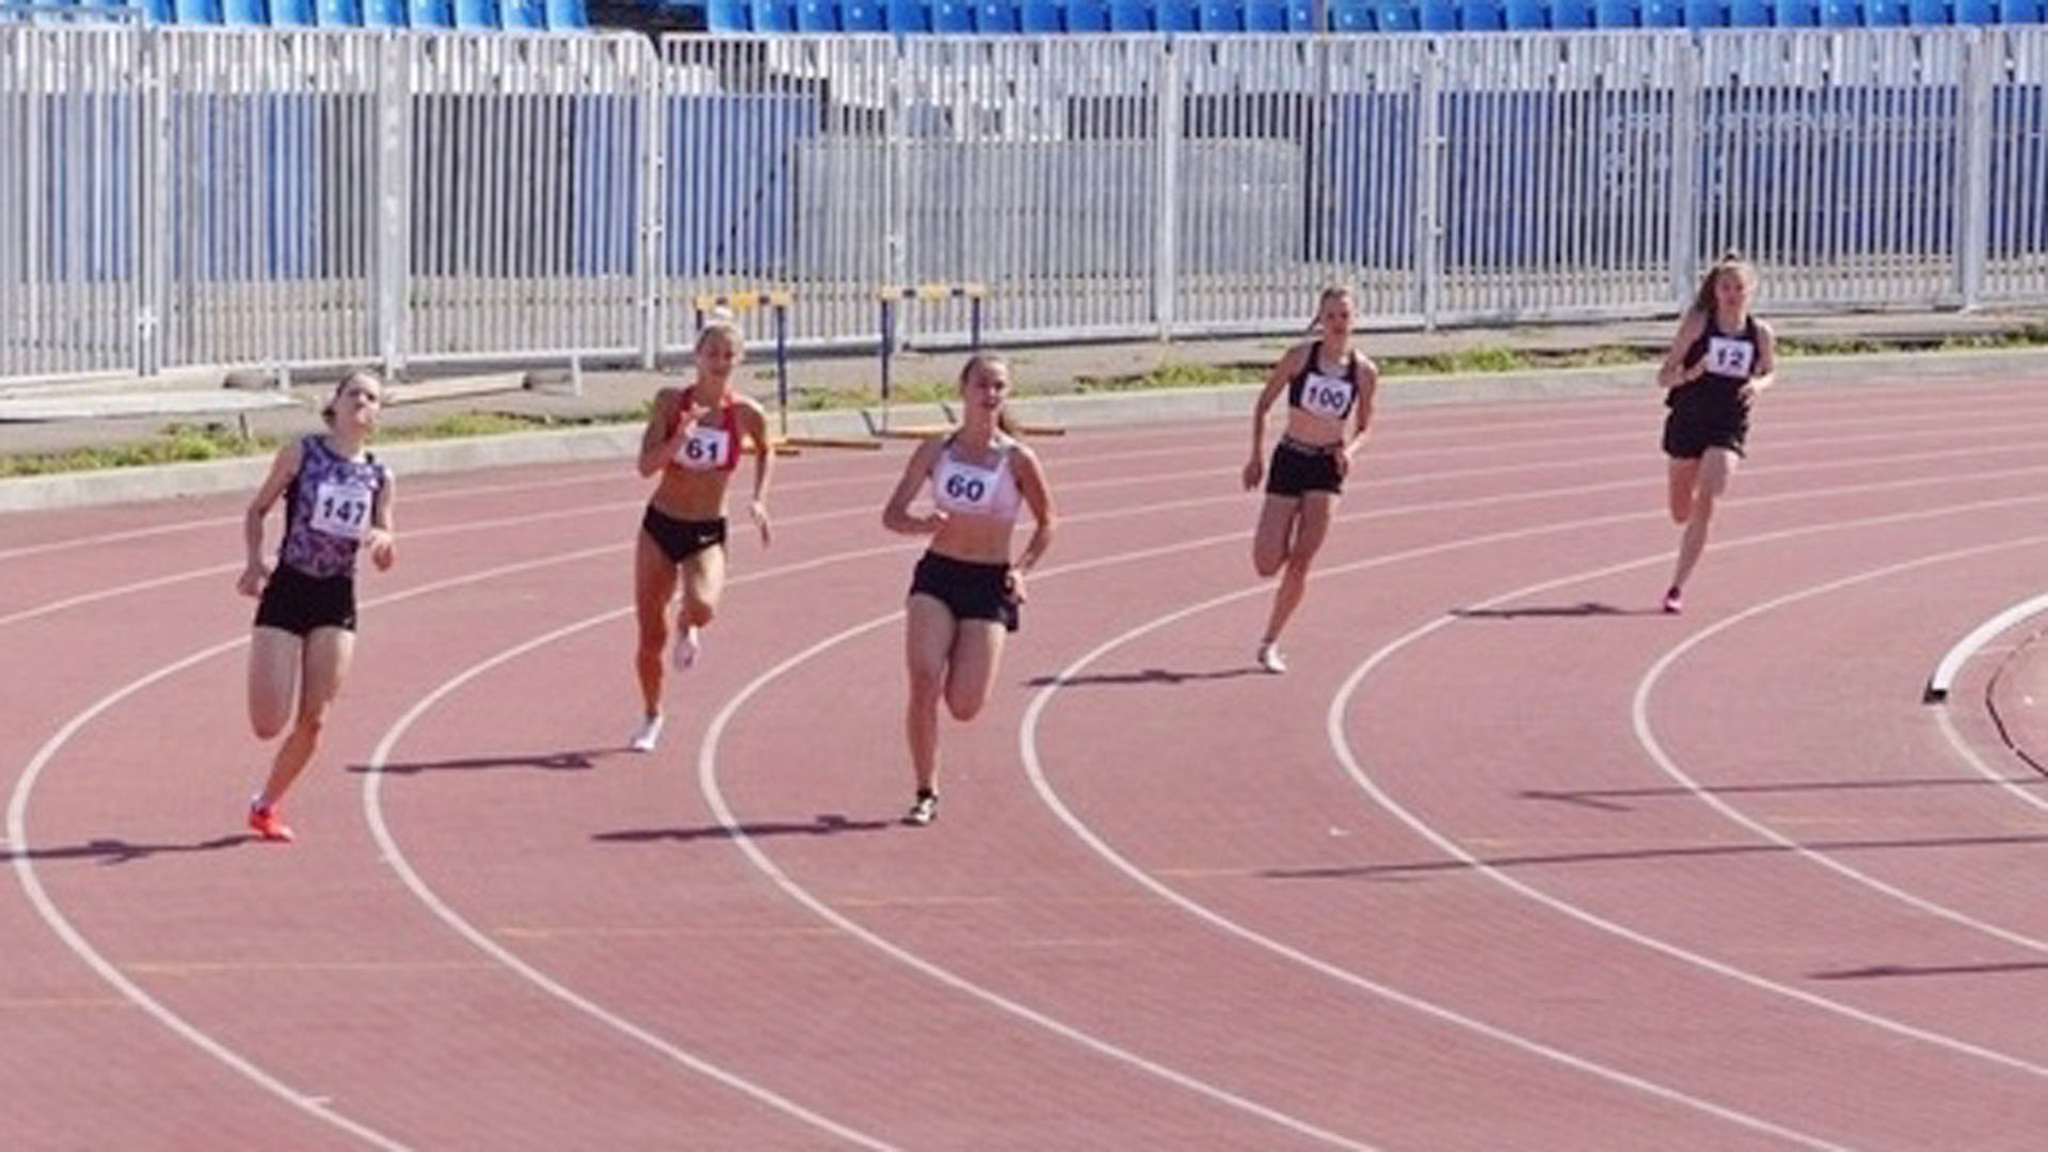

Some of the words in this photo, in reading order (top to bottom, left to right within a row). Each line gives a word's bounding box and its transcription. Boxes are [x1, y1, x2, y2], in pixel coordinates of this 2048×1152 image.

[1718, 348, 1744, 369] 12
[1308, 386, 1344, 409] 100
[686, 438, 718, 462] 61
[946, 474, 985, 502] 60
[324, 497, 366, 525] 147
